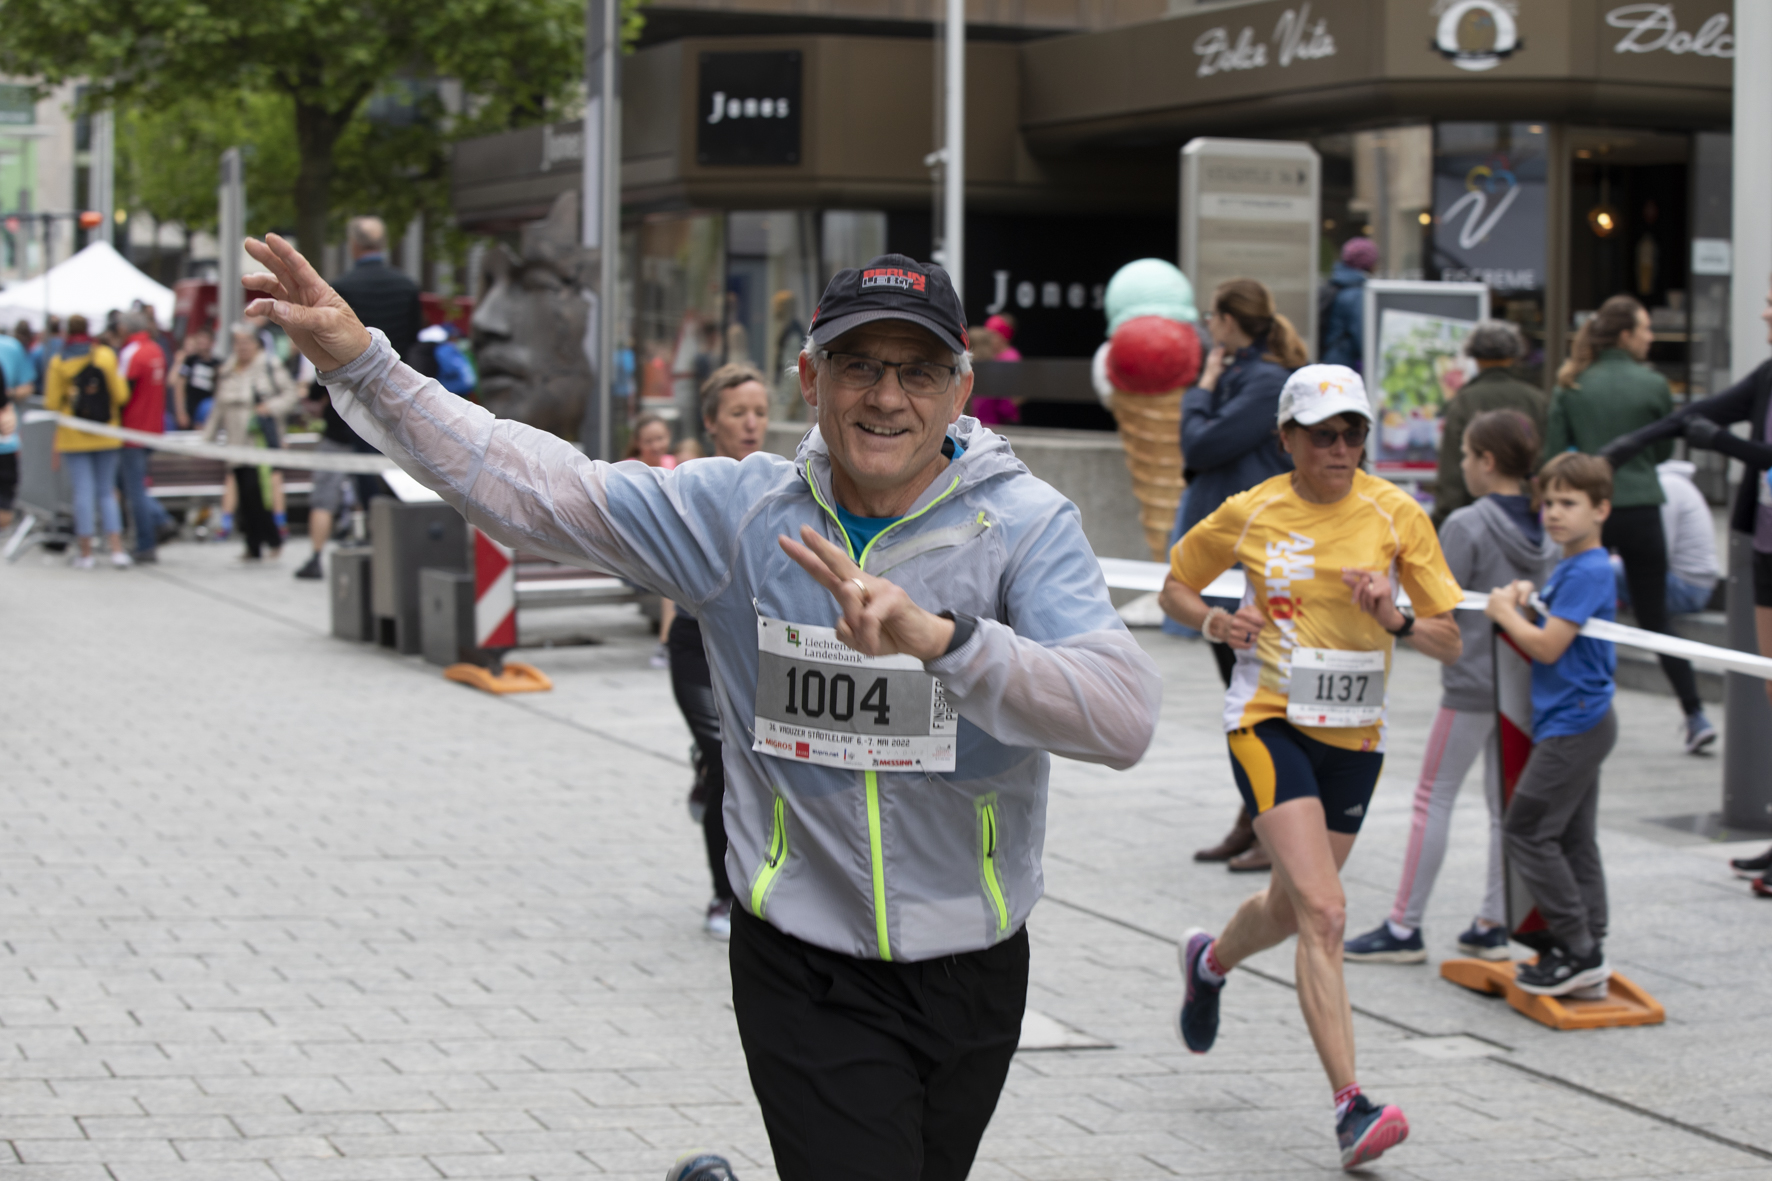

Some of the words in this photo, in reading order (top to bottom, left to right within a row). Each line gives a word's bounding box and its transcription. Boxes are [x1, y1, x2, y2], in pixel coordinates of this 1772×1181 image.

[1272, 2, 1336, 66] Vita
[1605, 3, 1733, 58] Dolc
[707, 91, 789, 124] Jones
[985, 270, 1105, 314] Jones
[1287, 531, 1315, 580] AM
[804, 648, 862, 663] Landesbank
[785, 666, 890, 725] 1004
[1316, 674, 1369, 702] 1137
[765, 737, 793, 751] MIGROS
[891, 739, 910, 747] 2022
